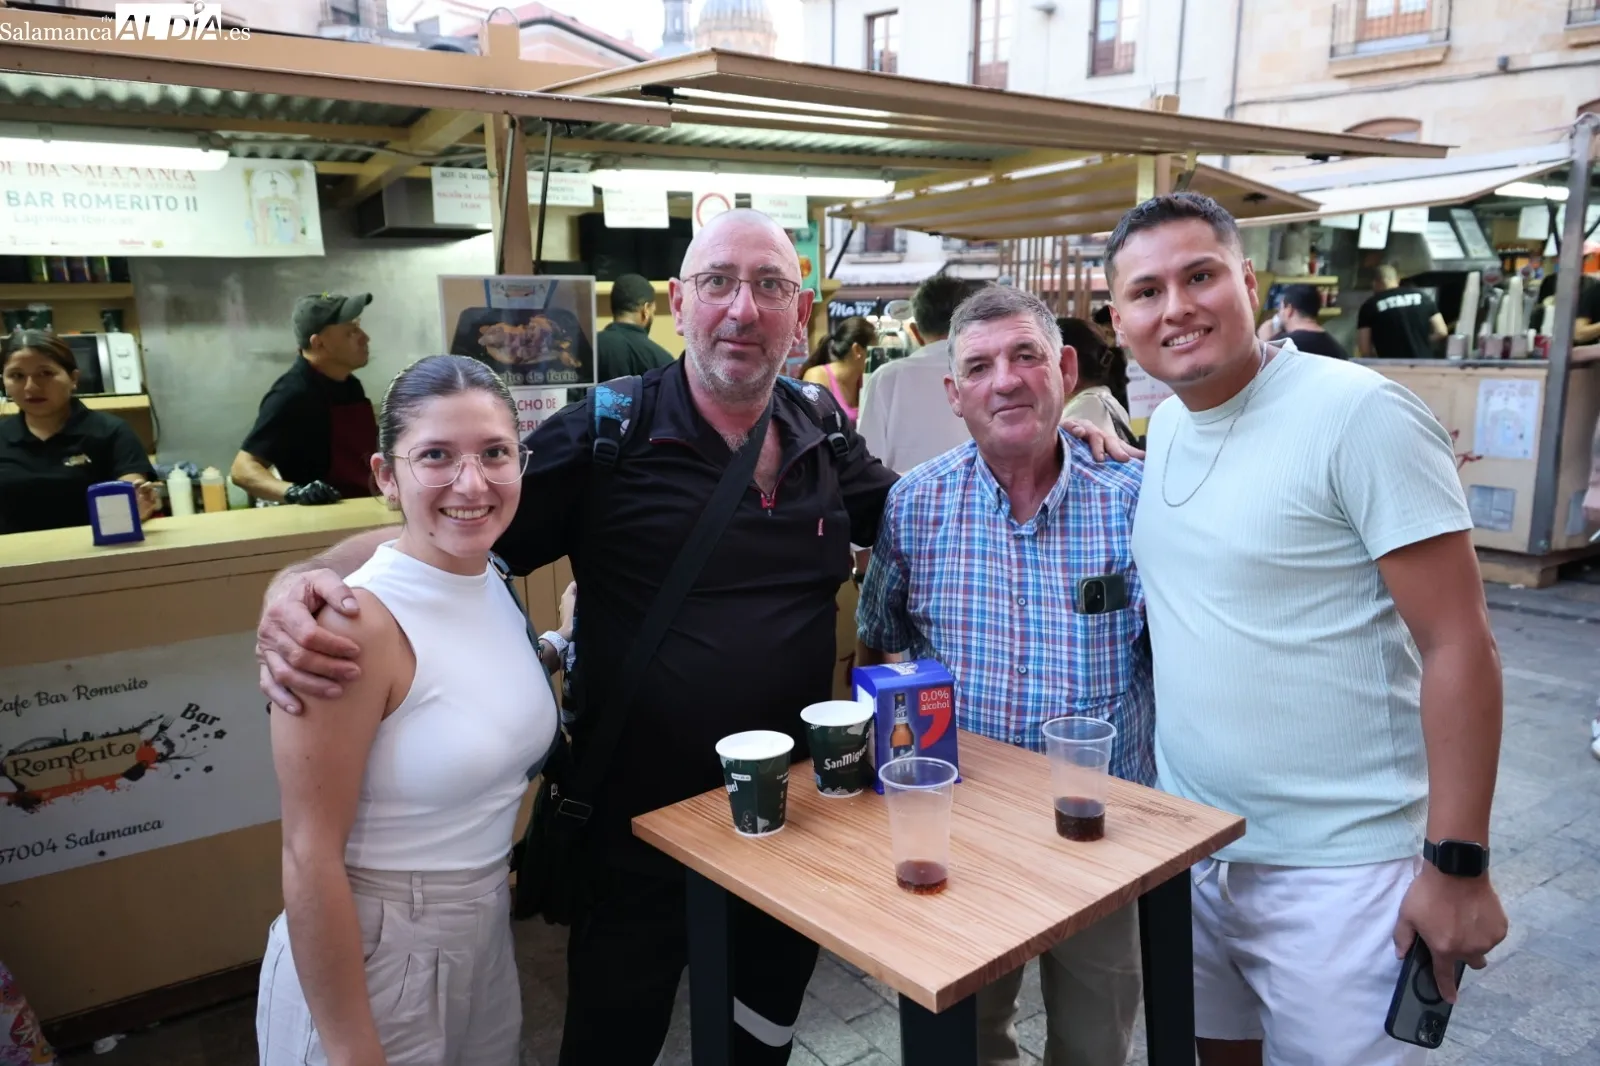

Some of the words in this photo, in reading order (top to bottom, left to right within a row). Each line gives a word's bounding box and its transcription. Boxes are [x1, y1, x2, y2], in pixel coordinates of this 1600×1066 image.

[5, 190, 54, 208] BAR
[62, 192, 179, 211] ROMERITO
[184, 195, 199, 212] II
[1377, 293, 1422, 312] STAFF
[500, 370, 523, 383] cho
[527, 370, 544, 382] de
[516, 398, 543, 411] CHO
[545, 398, 556, 409] DE
[519, 420, 540, 432] ERI
[34, 690, 69, 706] Bar
[73, 677, 148, 700] Romerito
[920, 690, 949, 702] 0,0%
[180, 702, 221, 726] Bar
[921, 699, 950, 711] alcohol
[11, 741, 136, 777] Romerito
[65, 819, 164, 849] Salamanca
